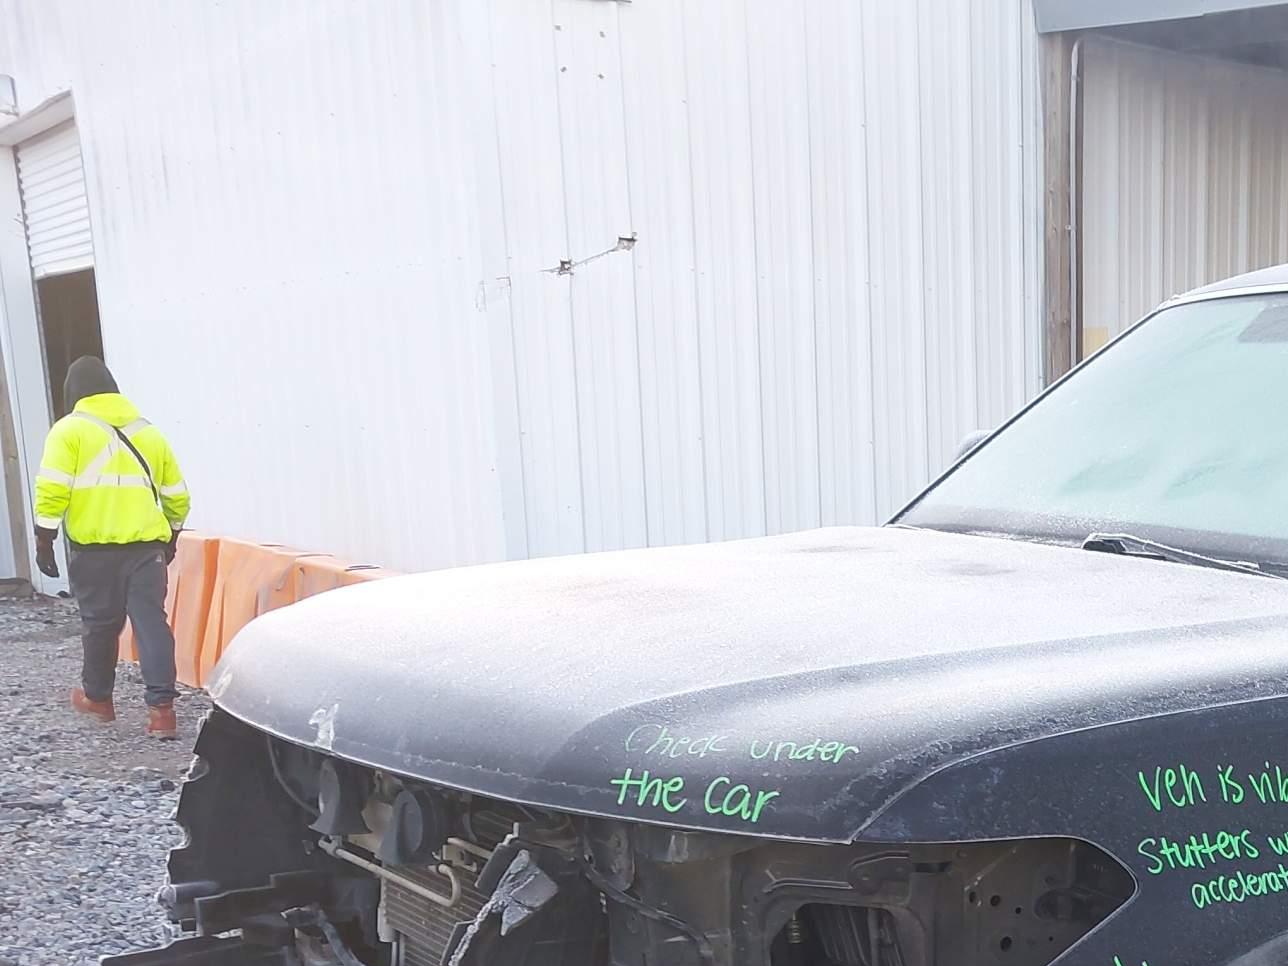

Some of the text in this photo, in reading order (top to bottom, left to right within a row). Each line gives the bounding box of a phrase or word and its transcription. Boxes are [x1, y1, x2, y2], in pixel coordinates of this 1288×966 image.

[749, 739, 860, 764] under
[610, 767, 688, 813] the
[1216, 764, 1246, 803] is
